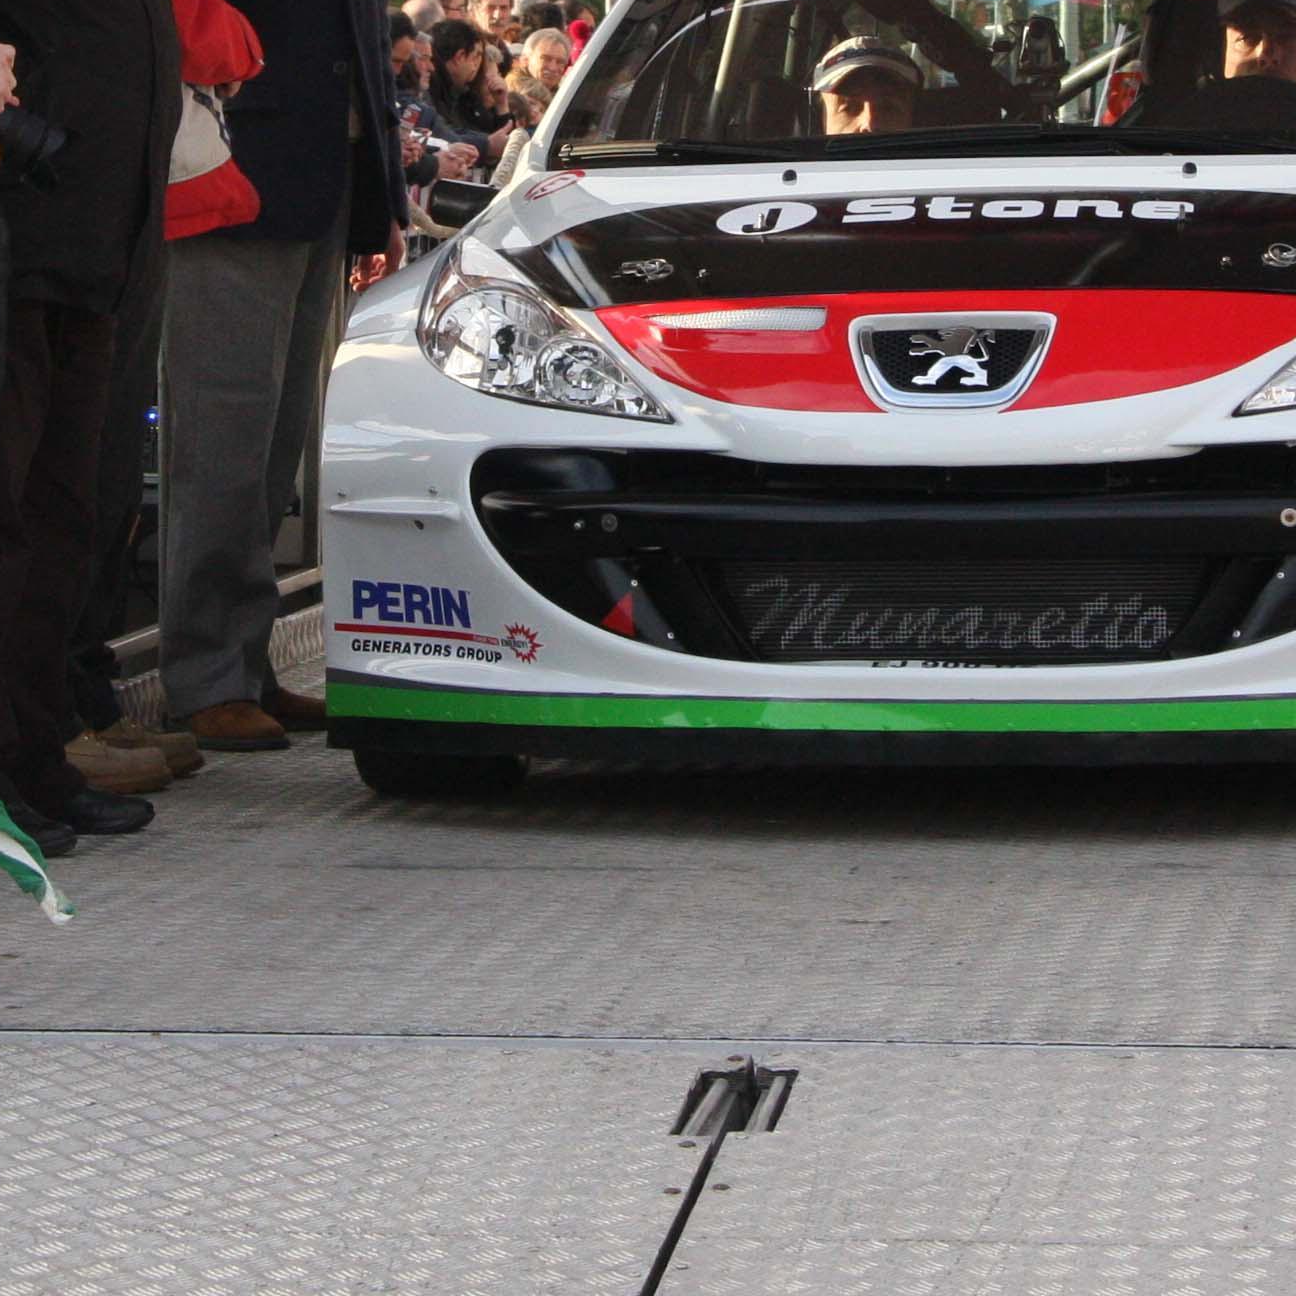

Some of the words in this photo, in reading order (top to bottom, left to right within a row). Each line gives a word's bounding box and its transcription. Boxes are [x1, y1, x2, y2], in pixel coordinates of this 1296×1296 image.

[351, 579, 472, 629] PERIN
[351, 638, 453, 658] GENERATORS
[456, 646, 503, 664] GROUP
